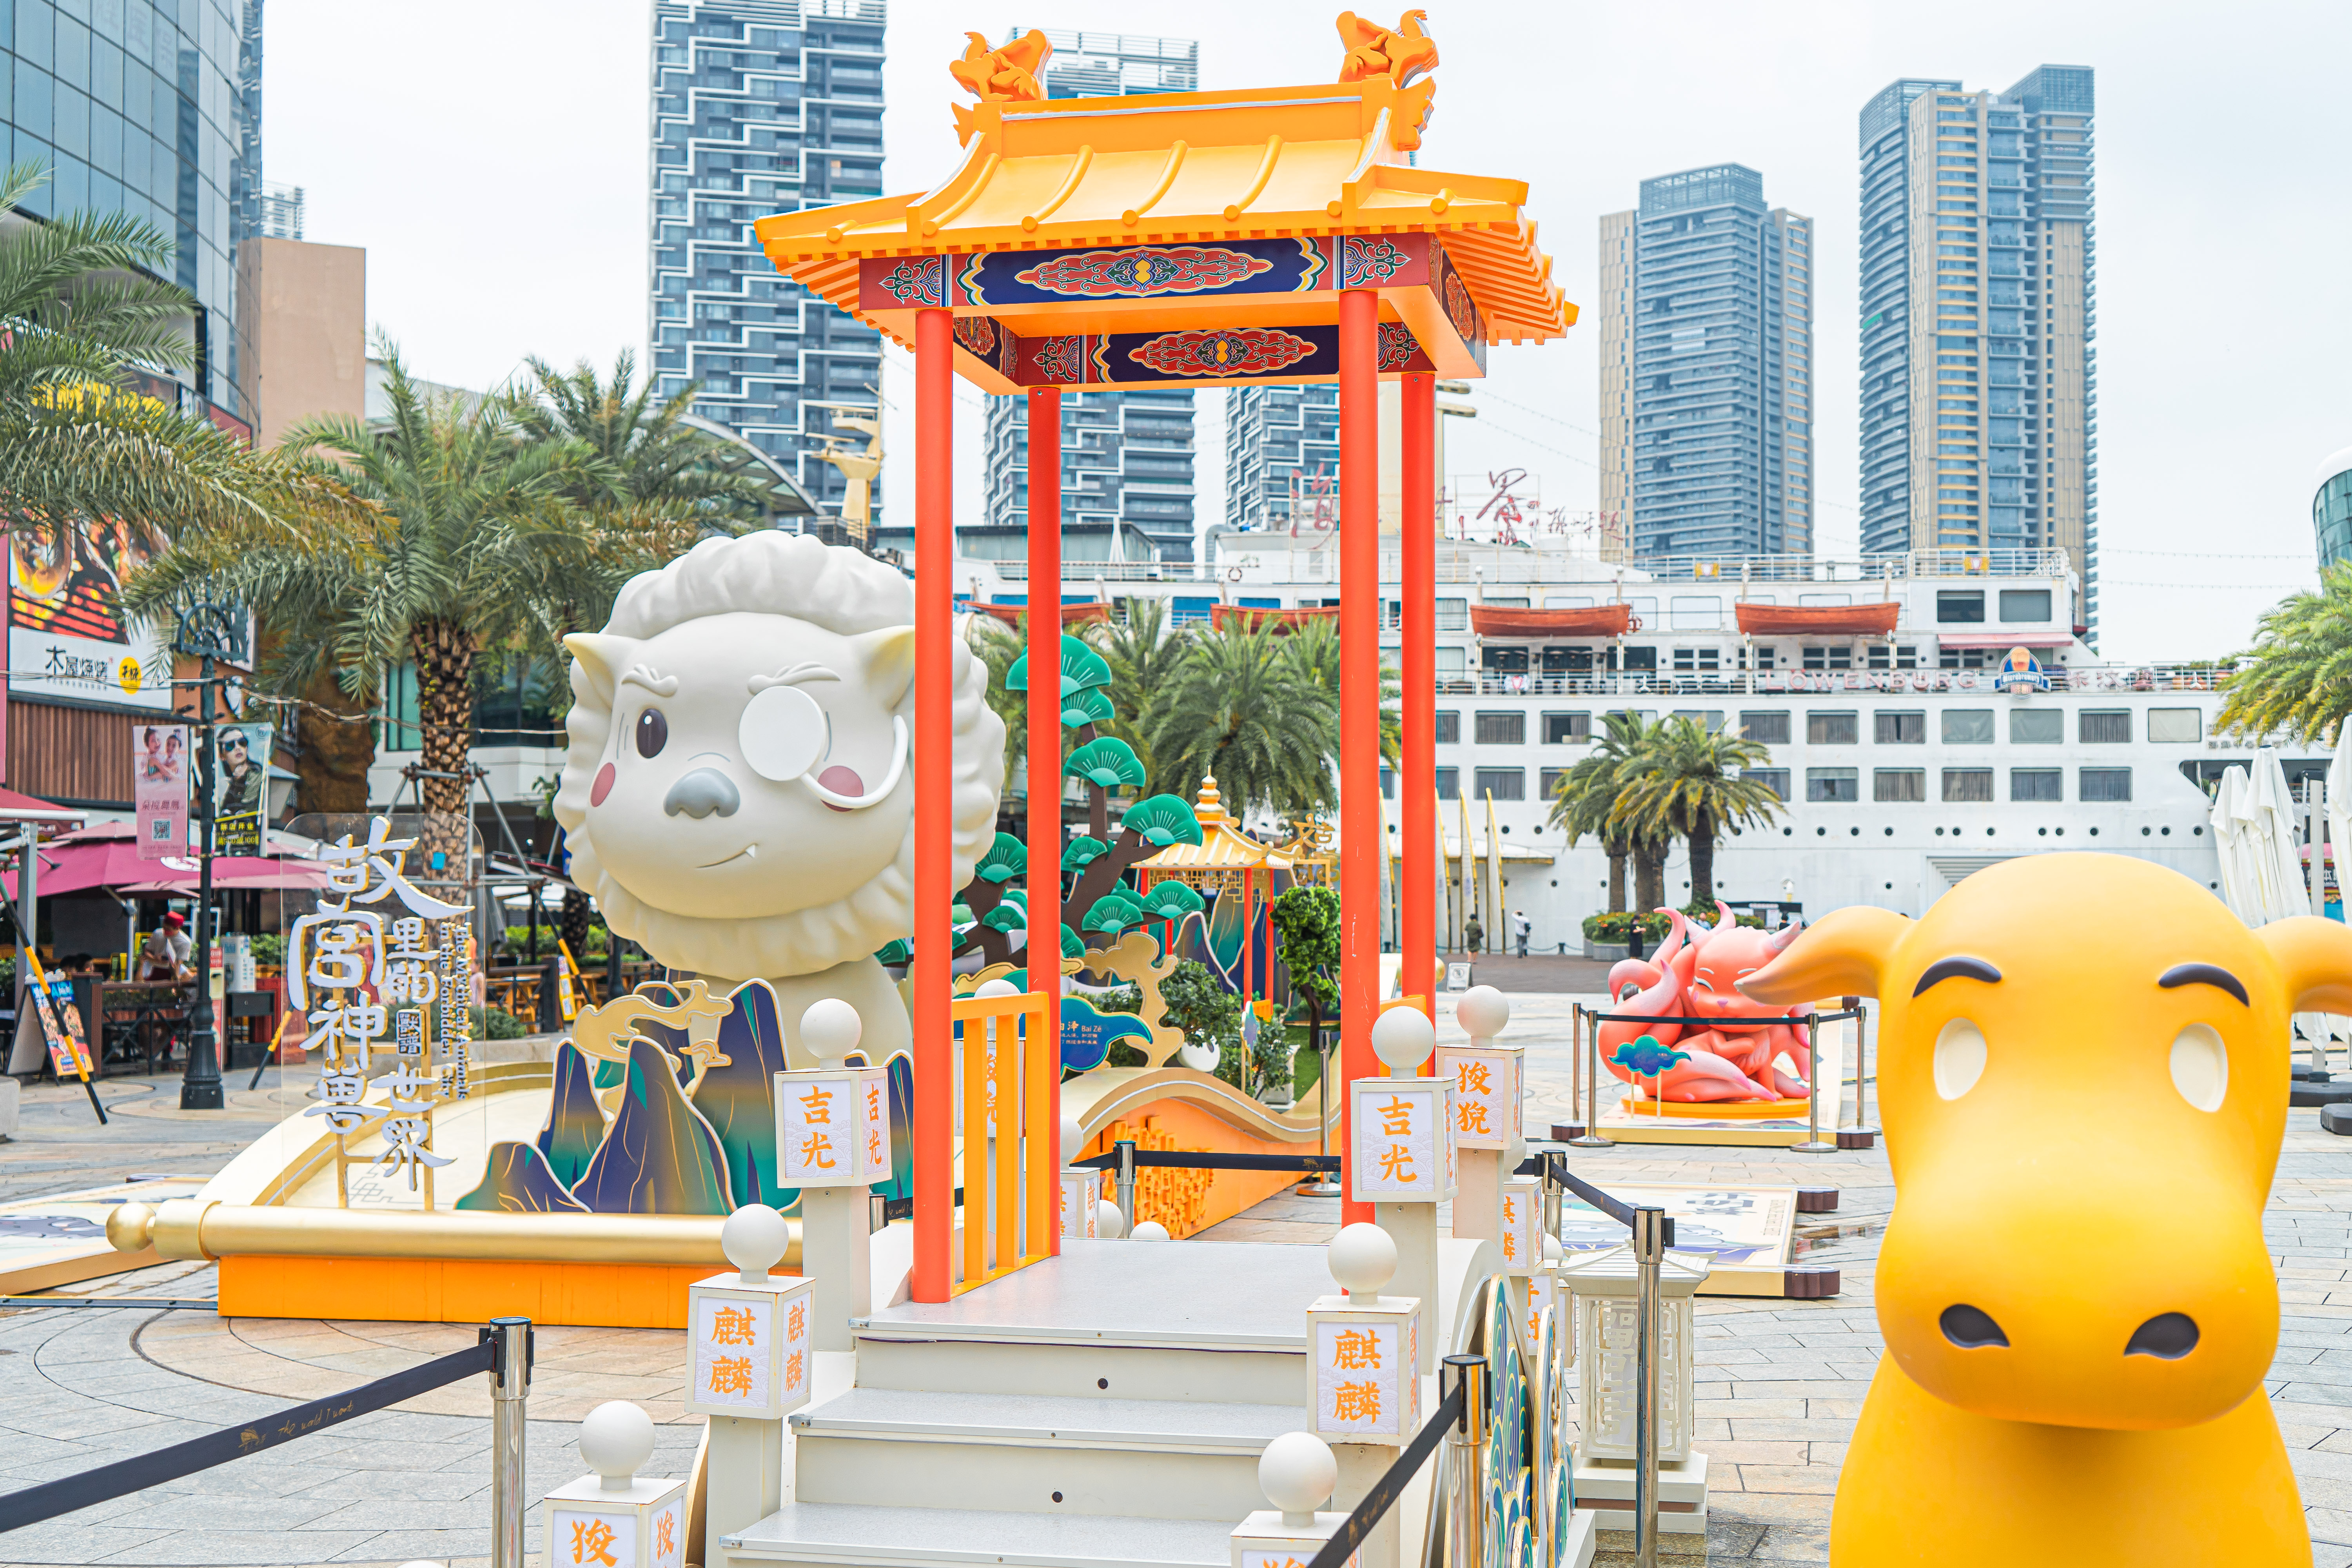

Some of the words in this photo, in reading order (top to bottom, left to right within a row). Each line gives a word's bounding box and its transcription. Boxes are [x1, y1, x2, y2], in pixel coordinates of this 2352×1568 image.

[1765, 668, 1975, 690] LÖWENBURG
[386, 917, 440, 1004] 里的
[439, 942, 456, 970] the
[440, 922, 456, 940] in
[456, 922, 472, 954] The
[439, 975, 457, 1058] Forbidden
[439, 1063, 456, 1098] City
[456, 1032, 472, 1100] Animals
[1456, 1061, 1492, 1134] 狻猊
[370, 1062, 458, 1191] 世界
[799, 1084, 836, 1169] 吉光
[867, 1082, 882, 1165] 吉光
[1377, 1094, 1417, 1183] 吉光
[708, 1305, 756, 1398] 麒麟
[785, 1300, 805, 1392] 麒麟
[1332, 1328, 1382, 1425] 麒麟
[278, 1420, 298, 1437] The
[333, 1399, 354, 1419] want
